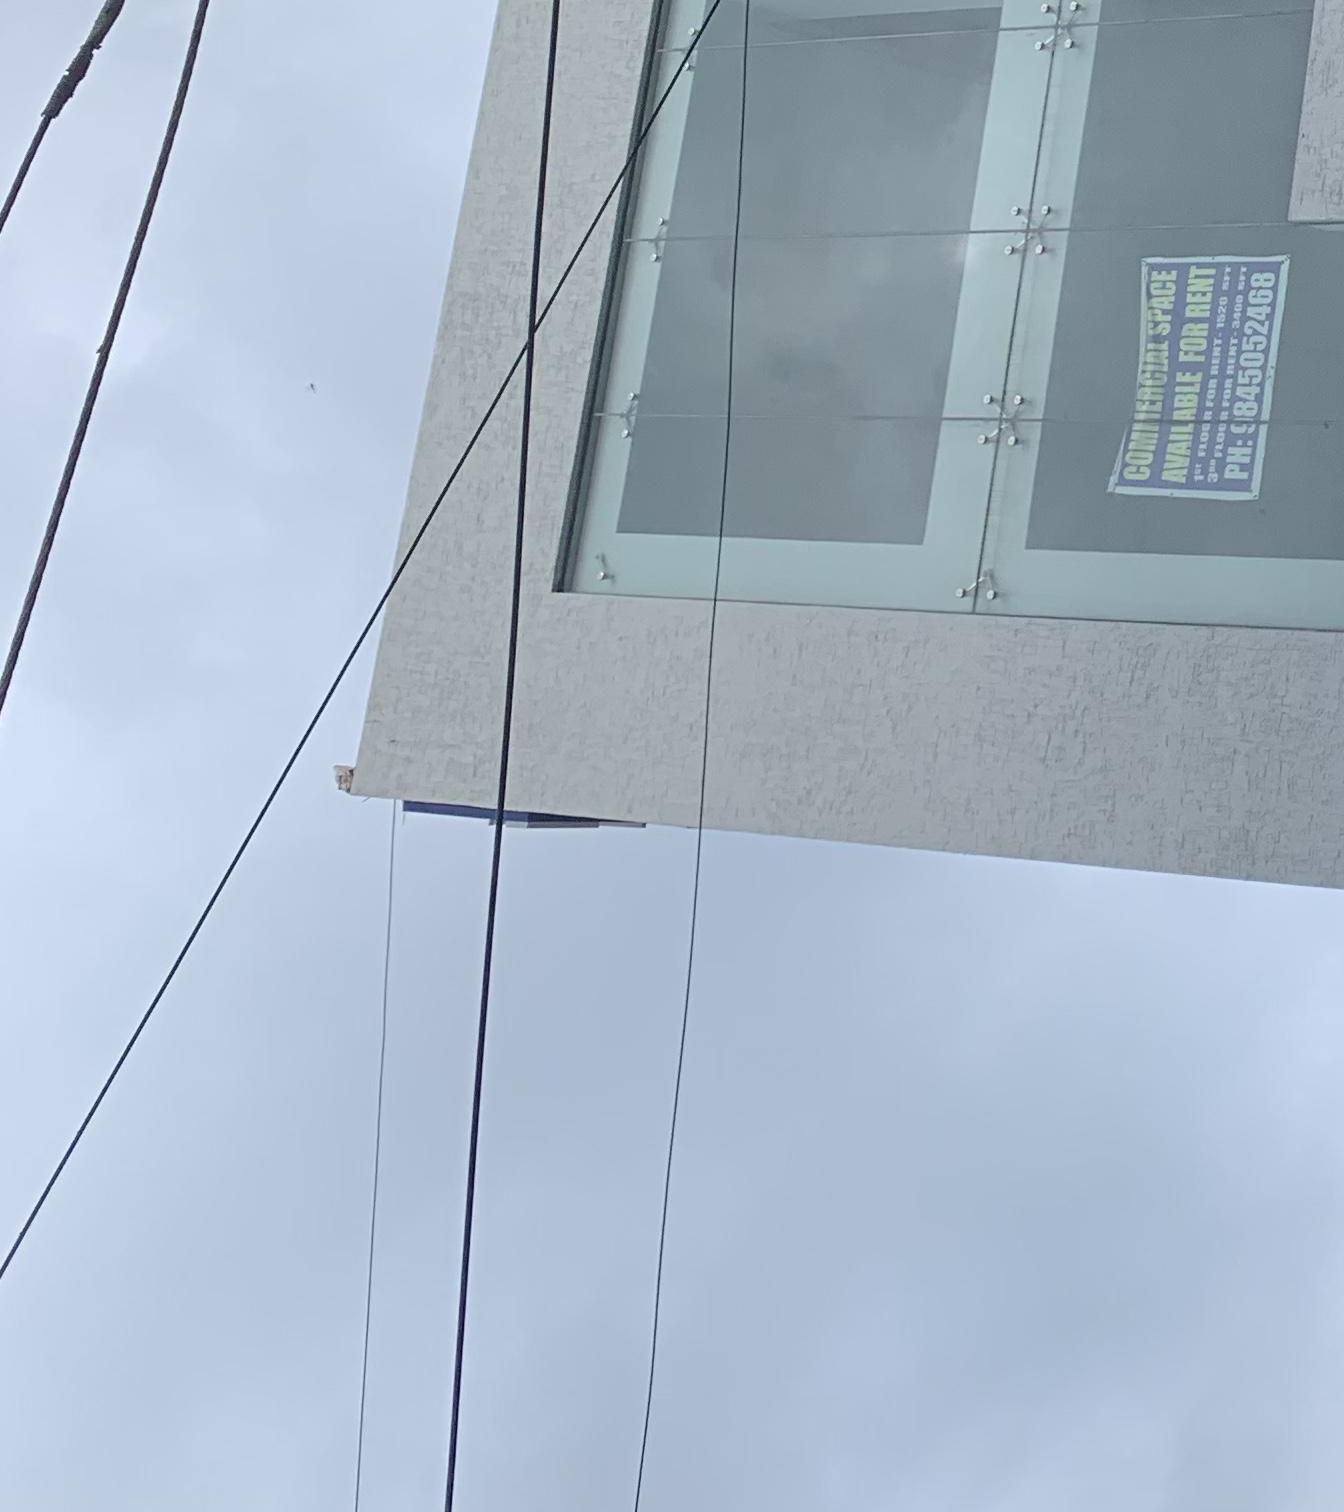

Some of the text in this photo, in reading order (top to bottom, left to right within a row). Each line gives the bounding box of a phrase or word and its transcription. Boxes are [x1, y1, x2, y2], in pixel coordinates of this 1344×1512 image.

[1231, 294, 1244, 329] 3400
[1122, 269, 1178, 481] COMMERCIAL SPACE
[1161, 264, 1217, 484] AVAILABLE FOR RENT
[1221, 378, 1234, 408] FOR
[1223, 272, 1276, 480] PH: 9845052468
[1197, 410, 1213, 458] FLOOR
[1205, 378, 1218, 408] FOR
[1213, 410, 1230, 458] FLOOR
